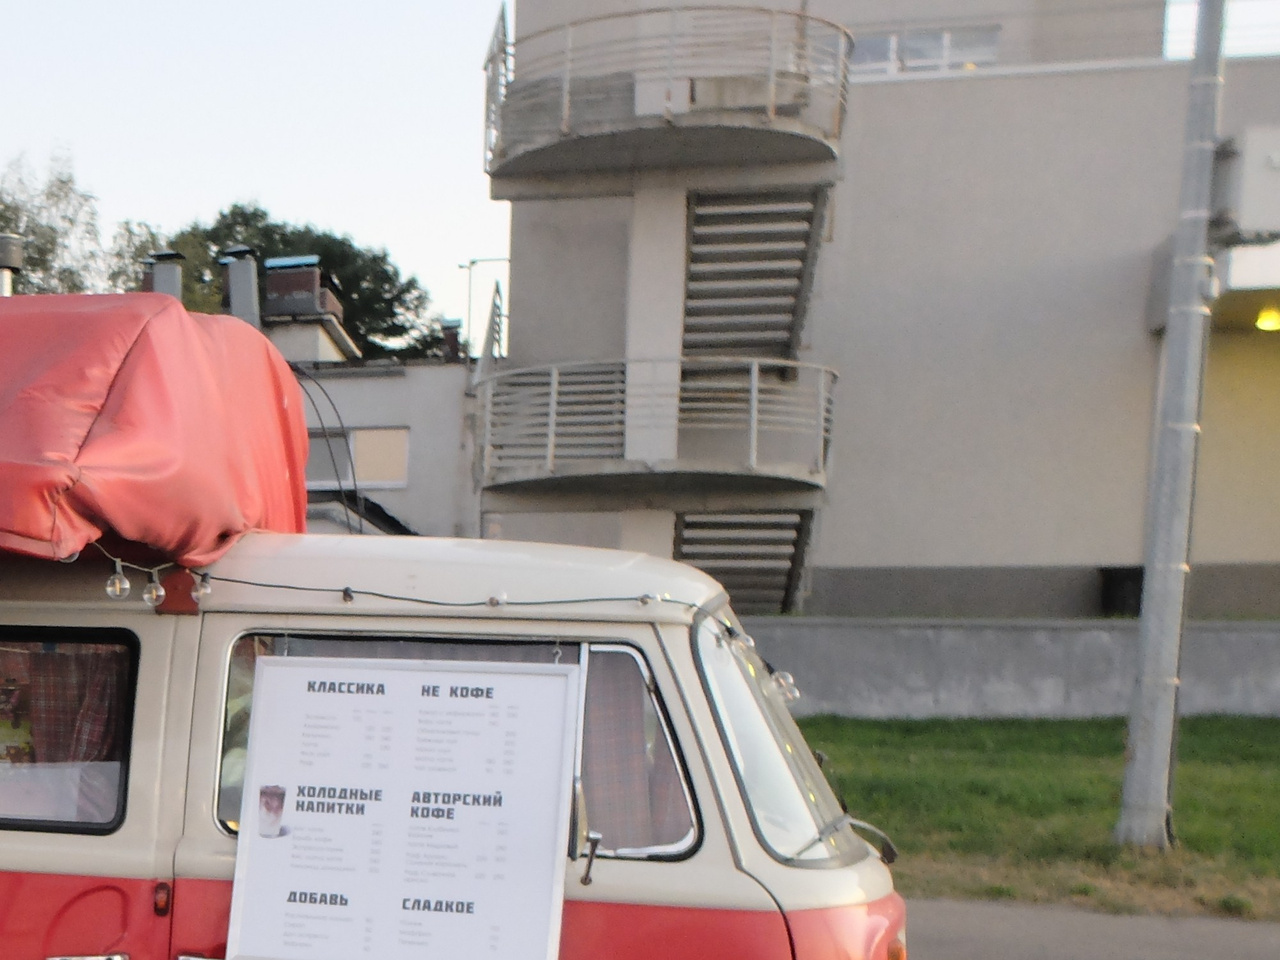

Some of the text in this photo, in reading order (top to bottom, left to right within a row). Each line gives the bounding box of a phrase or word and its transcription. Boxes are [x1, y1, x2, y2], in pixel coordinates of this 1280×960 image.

[307, 681, 386, 696] КЛАССИКА
[421, 684, 494, 700] НЕ КОФЕ
[296, 785, 383, 802] ХОЛОДНЫЕ
[411, 790, 503, 809] АВТОРСКИЙ
[295, 800, 365, 816] НАПИТКИ
[410, 805, 455, 820] КОФЕ
[286, 891, 349, 907] ДОБАВЬ
[402, 898, 474, 914] СЛАДКОЕ
